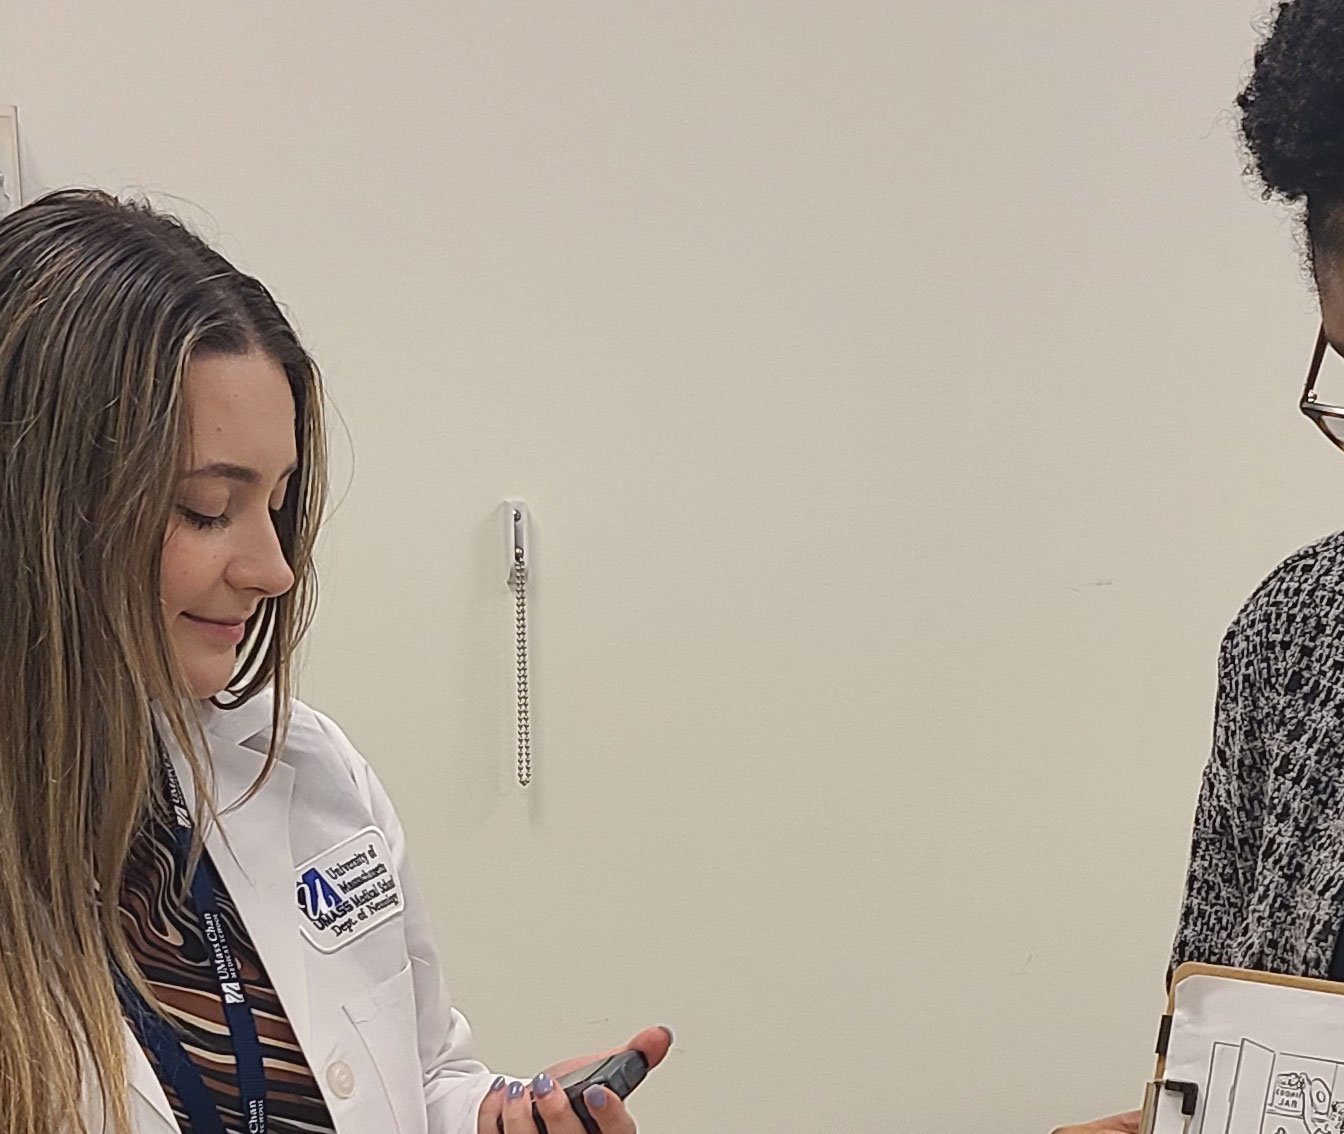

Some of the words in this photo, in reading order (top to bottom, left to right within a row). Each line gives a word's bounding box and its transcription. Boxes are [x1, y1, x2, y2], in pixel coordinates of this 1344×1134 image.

[204, 912, 218, 938] Chan
[313, 900, 354, 931] UMASS
[209, 938, 229, 981] UMass
[248, 1100, 258, 1134] Chan
